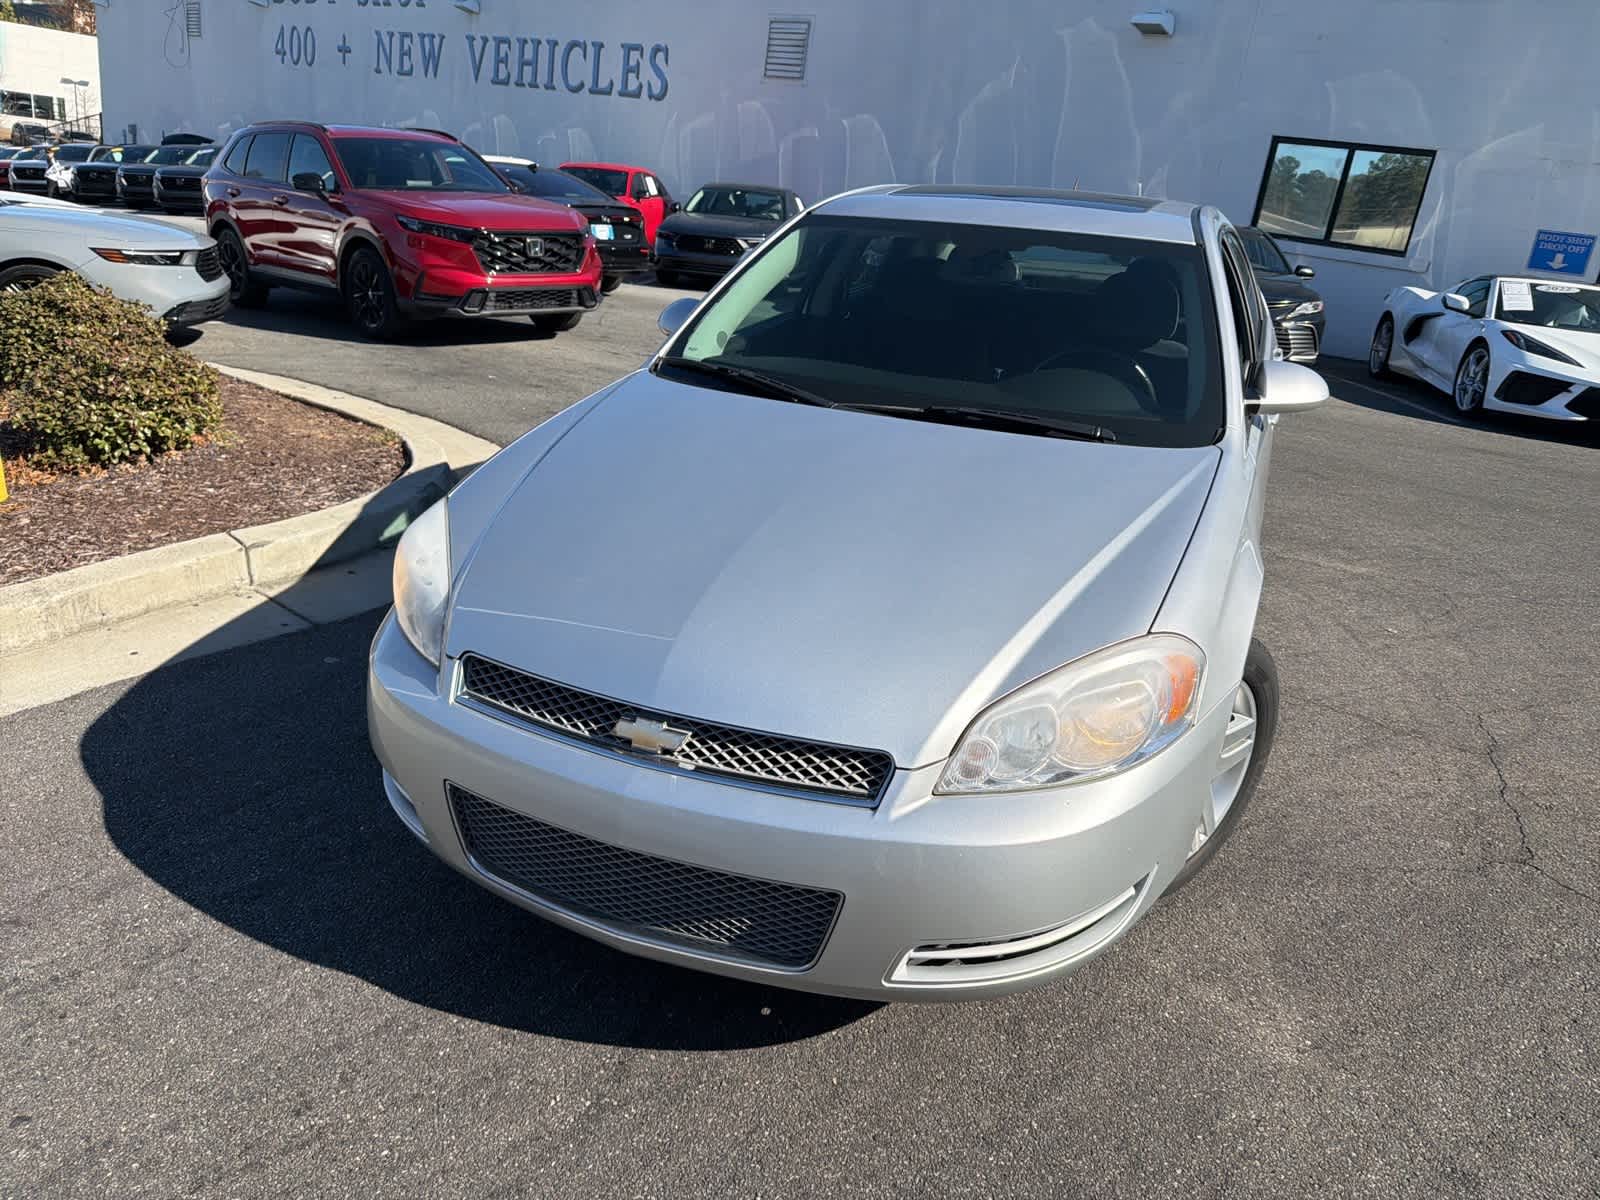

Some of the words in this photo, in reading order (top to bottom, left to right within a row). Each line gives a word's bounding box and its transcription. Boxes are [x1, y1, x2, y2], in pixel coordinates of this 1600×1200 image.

[275, 24, 316, 67] 400
[337, 33, 352, 66] +
[374, 29, 446, 79] NEW
[465, 34, 670, 102] VEHICLES
[1538, 241, 1568, 252] DROP
[1567, 244, 1586, 254] OFF
[1567, 236, 1593, 246] SHOP
